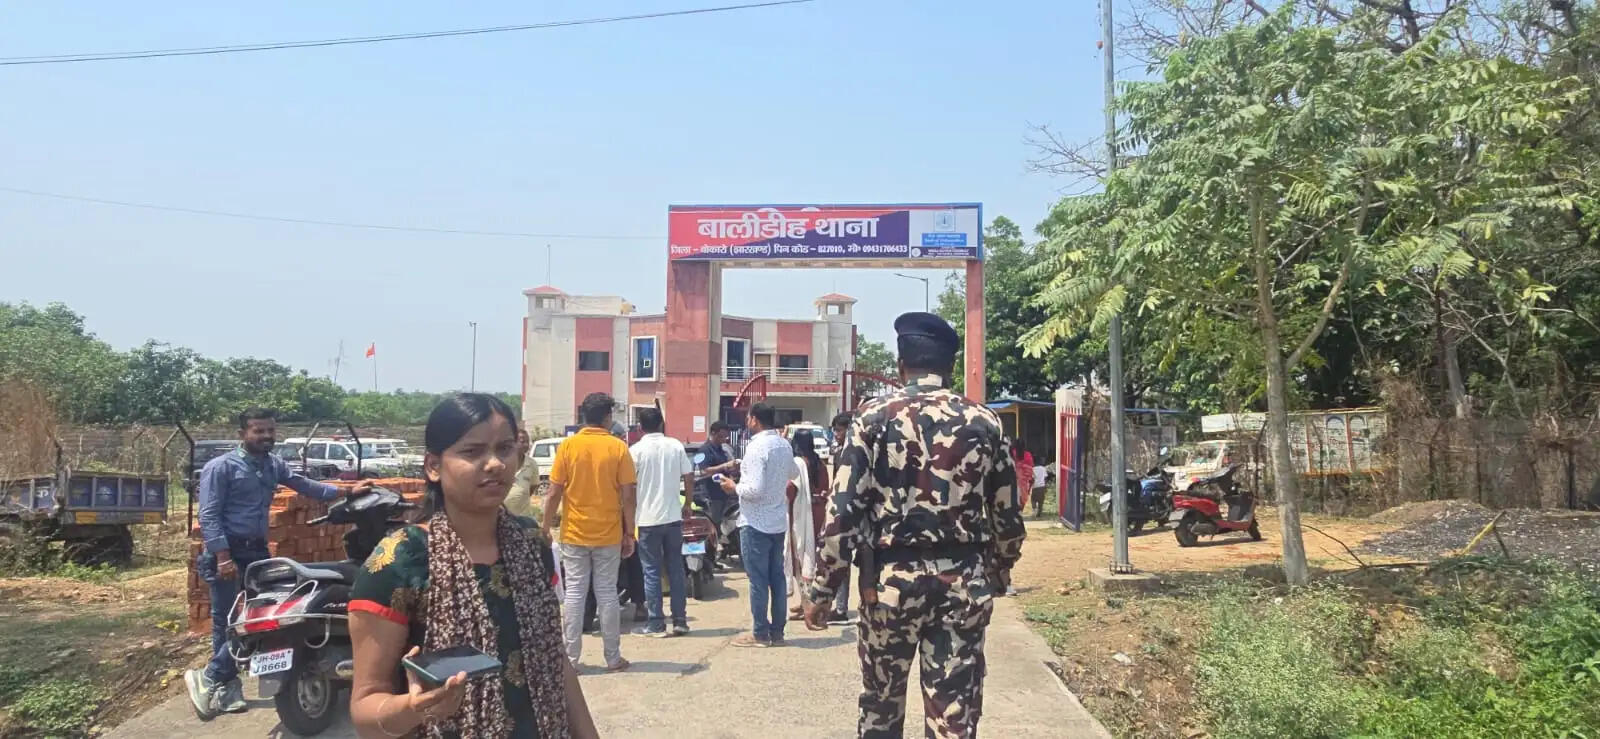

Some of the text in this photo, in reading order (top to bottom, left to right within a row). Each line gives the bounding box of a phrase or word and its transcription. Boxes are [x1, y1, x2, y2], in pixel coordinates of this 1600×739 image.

[697, 211, 880, 238] बालीडीह थाना
[670, 244, 691, 254] जिला
[700, 244, 728, 254] बोकारो
[774, 243, 790, 254] पिन
[791, 243, 809, 254] कोड
